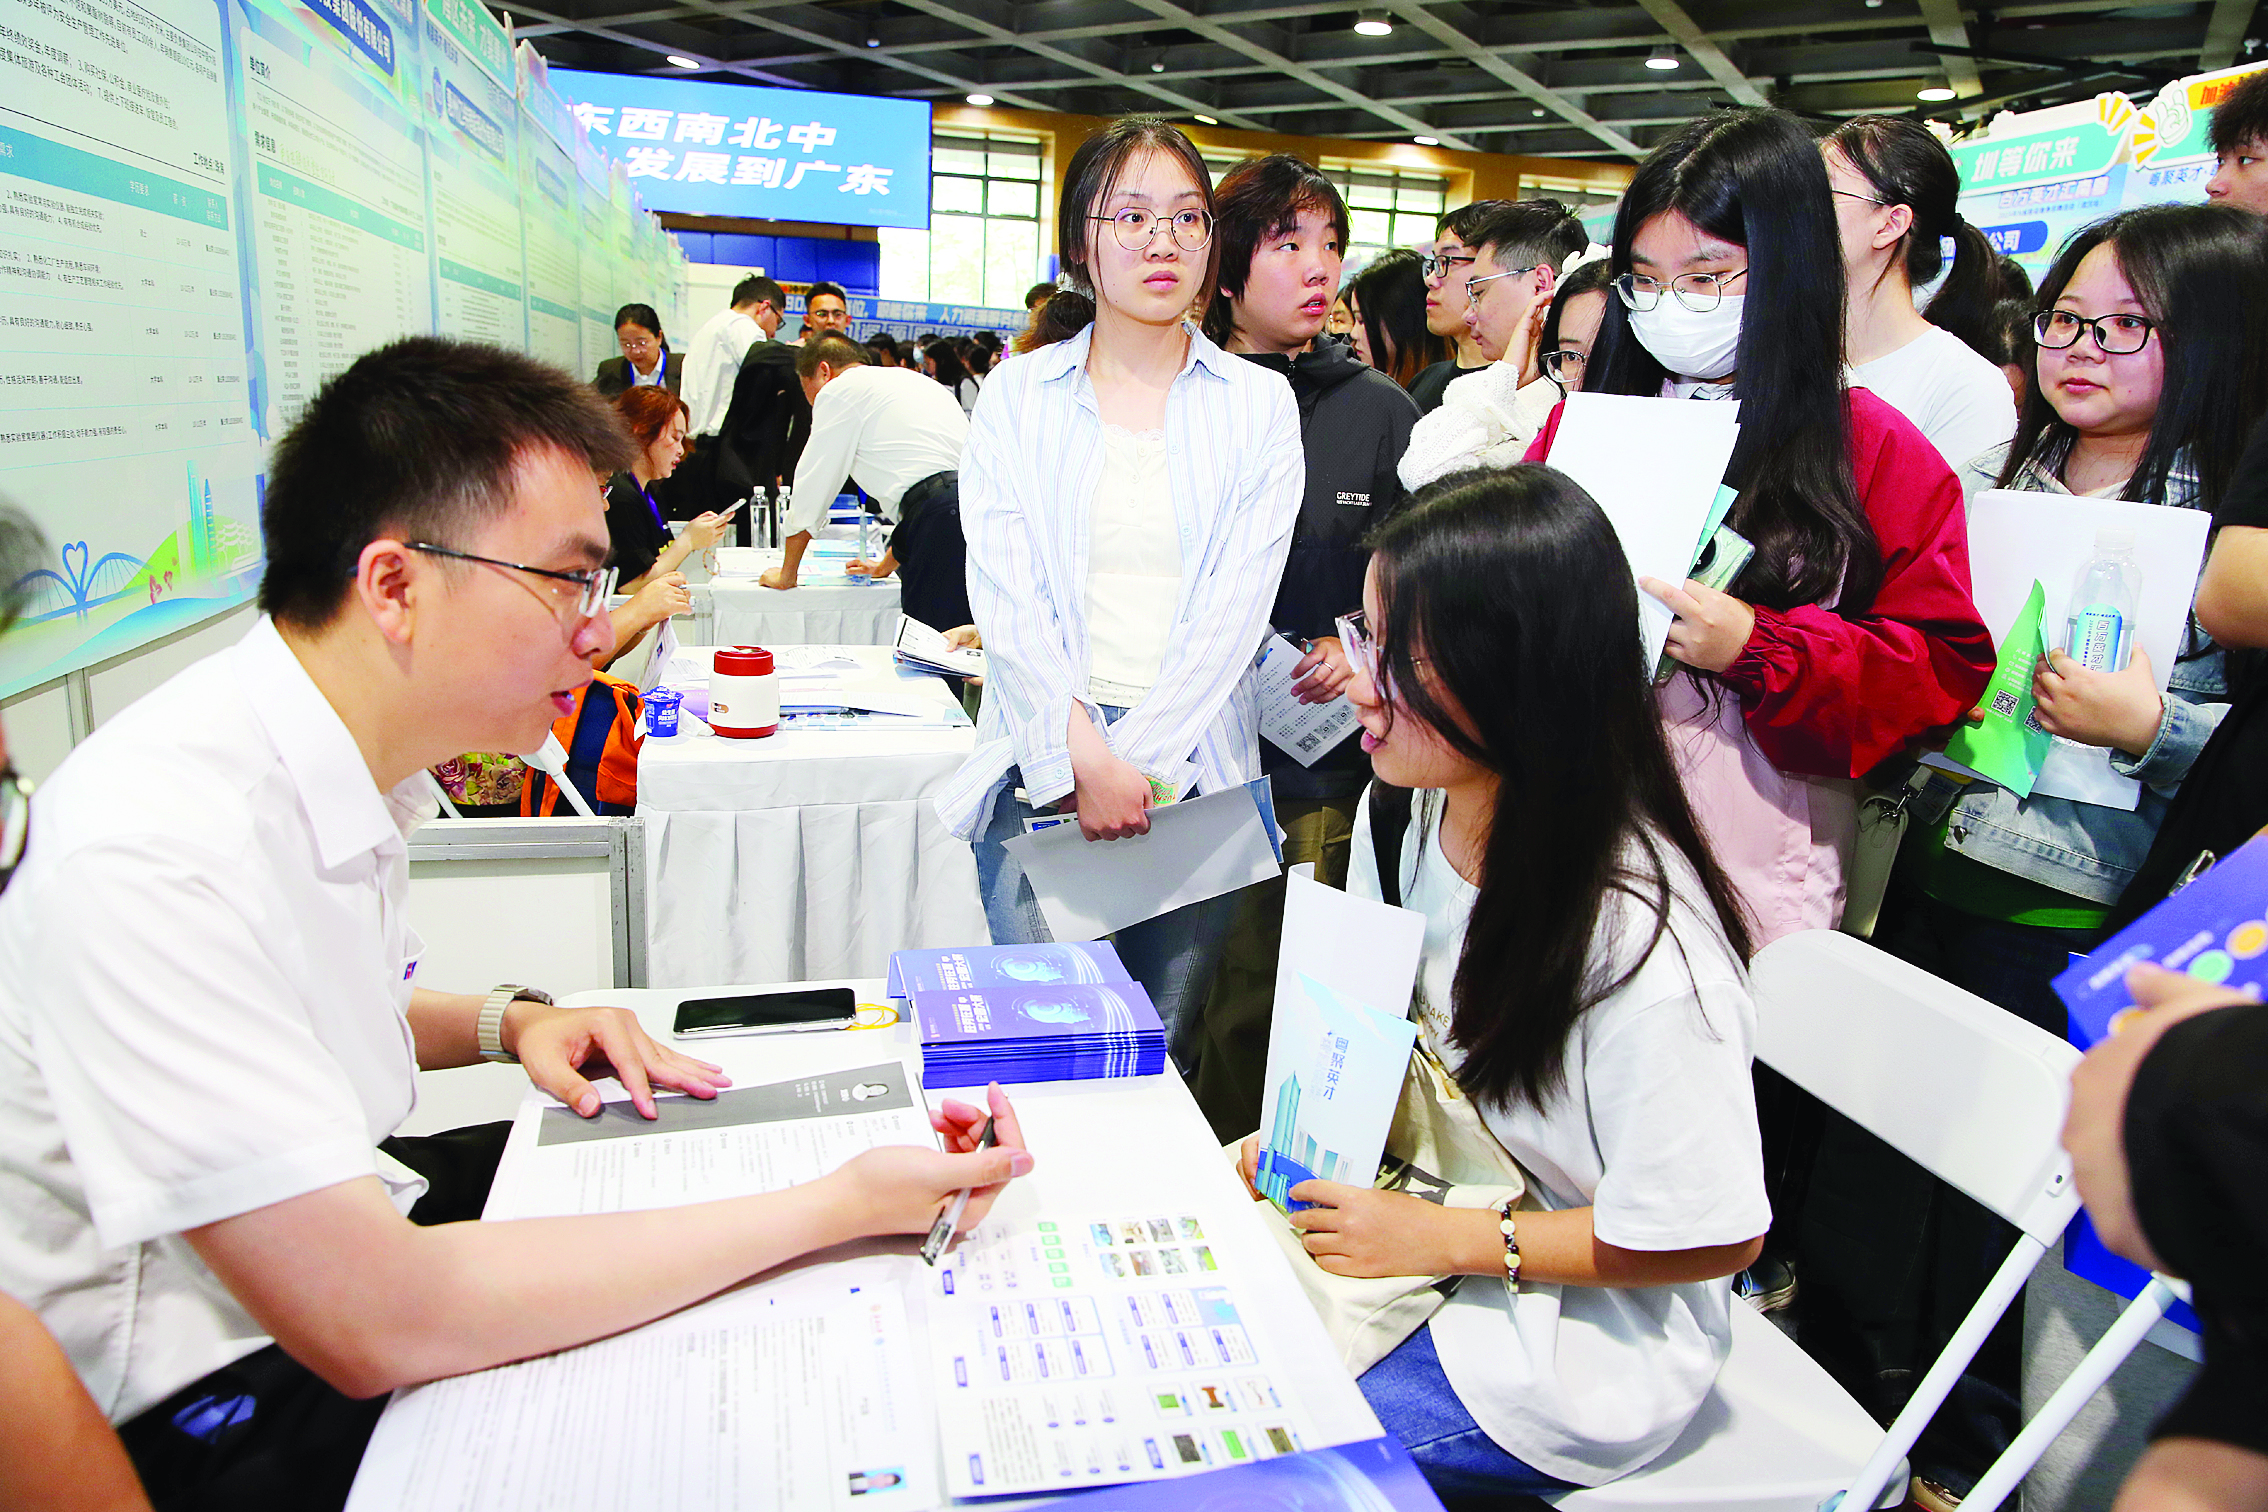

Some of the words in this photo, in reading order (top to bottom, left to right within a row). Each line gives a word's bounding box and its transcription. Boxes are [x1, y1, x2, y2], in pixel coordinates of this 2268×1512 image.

[565, 101, 837, 154] 东西南北中
[626, 146, 894, 196] 发展到广东
[1970, 136, 2080, 182] 圳等你来
[1336, 491, 1370, 502] GREYTIDE
[1323, 1036, 1349, 1101] 粤聚英才
